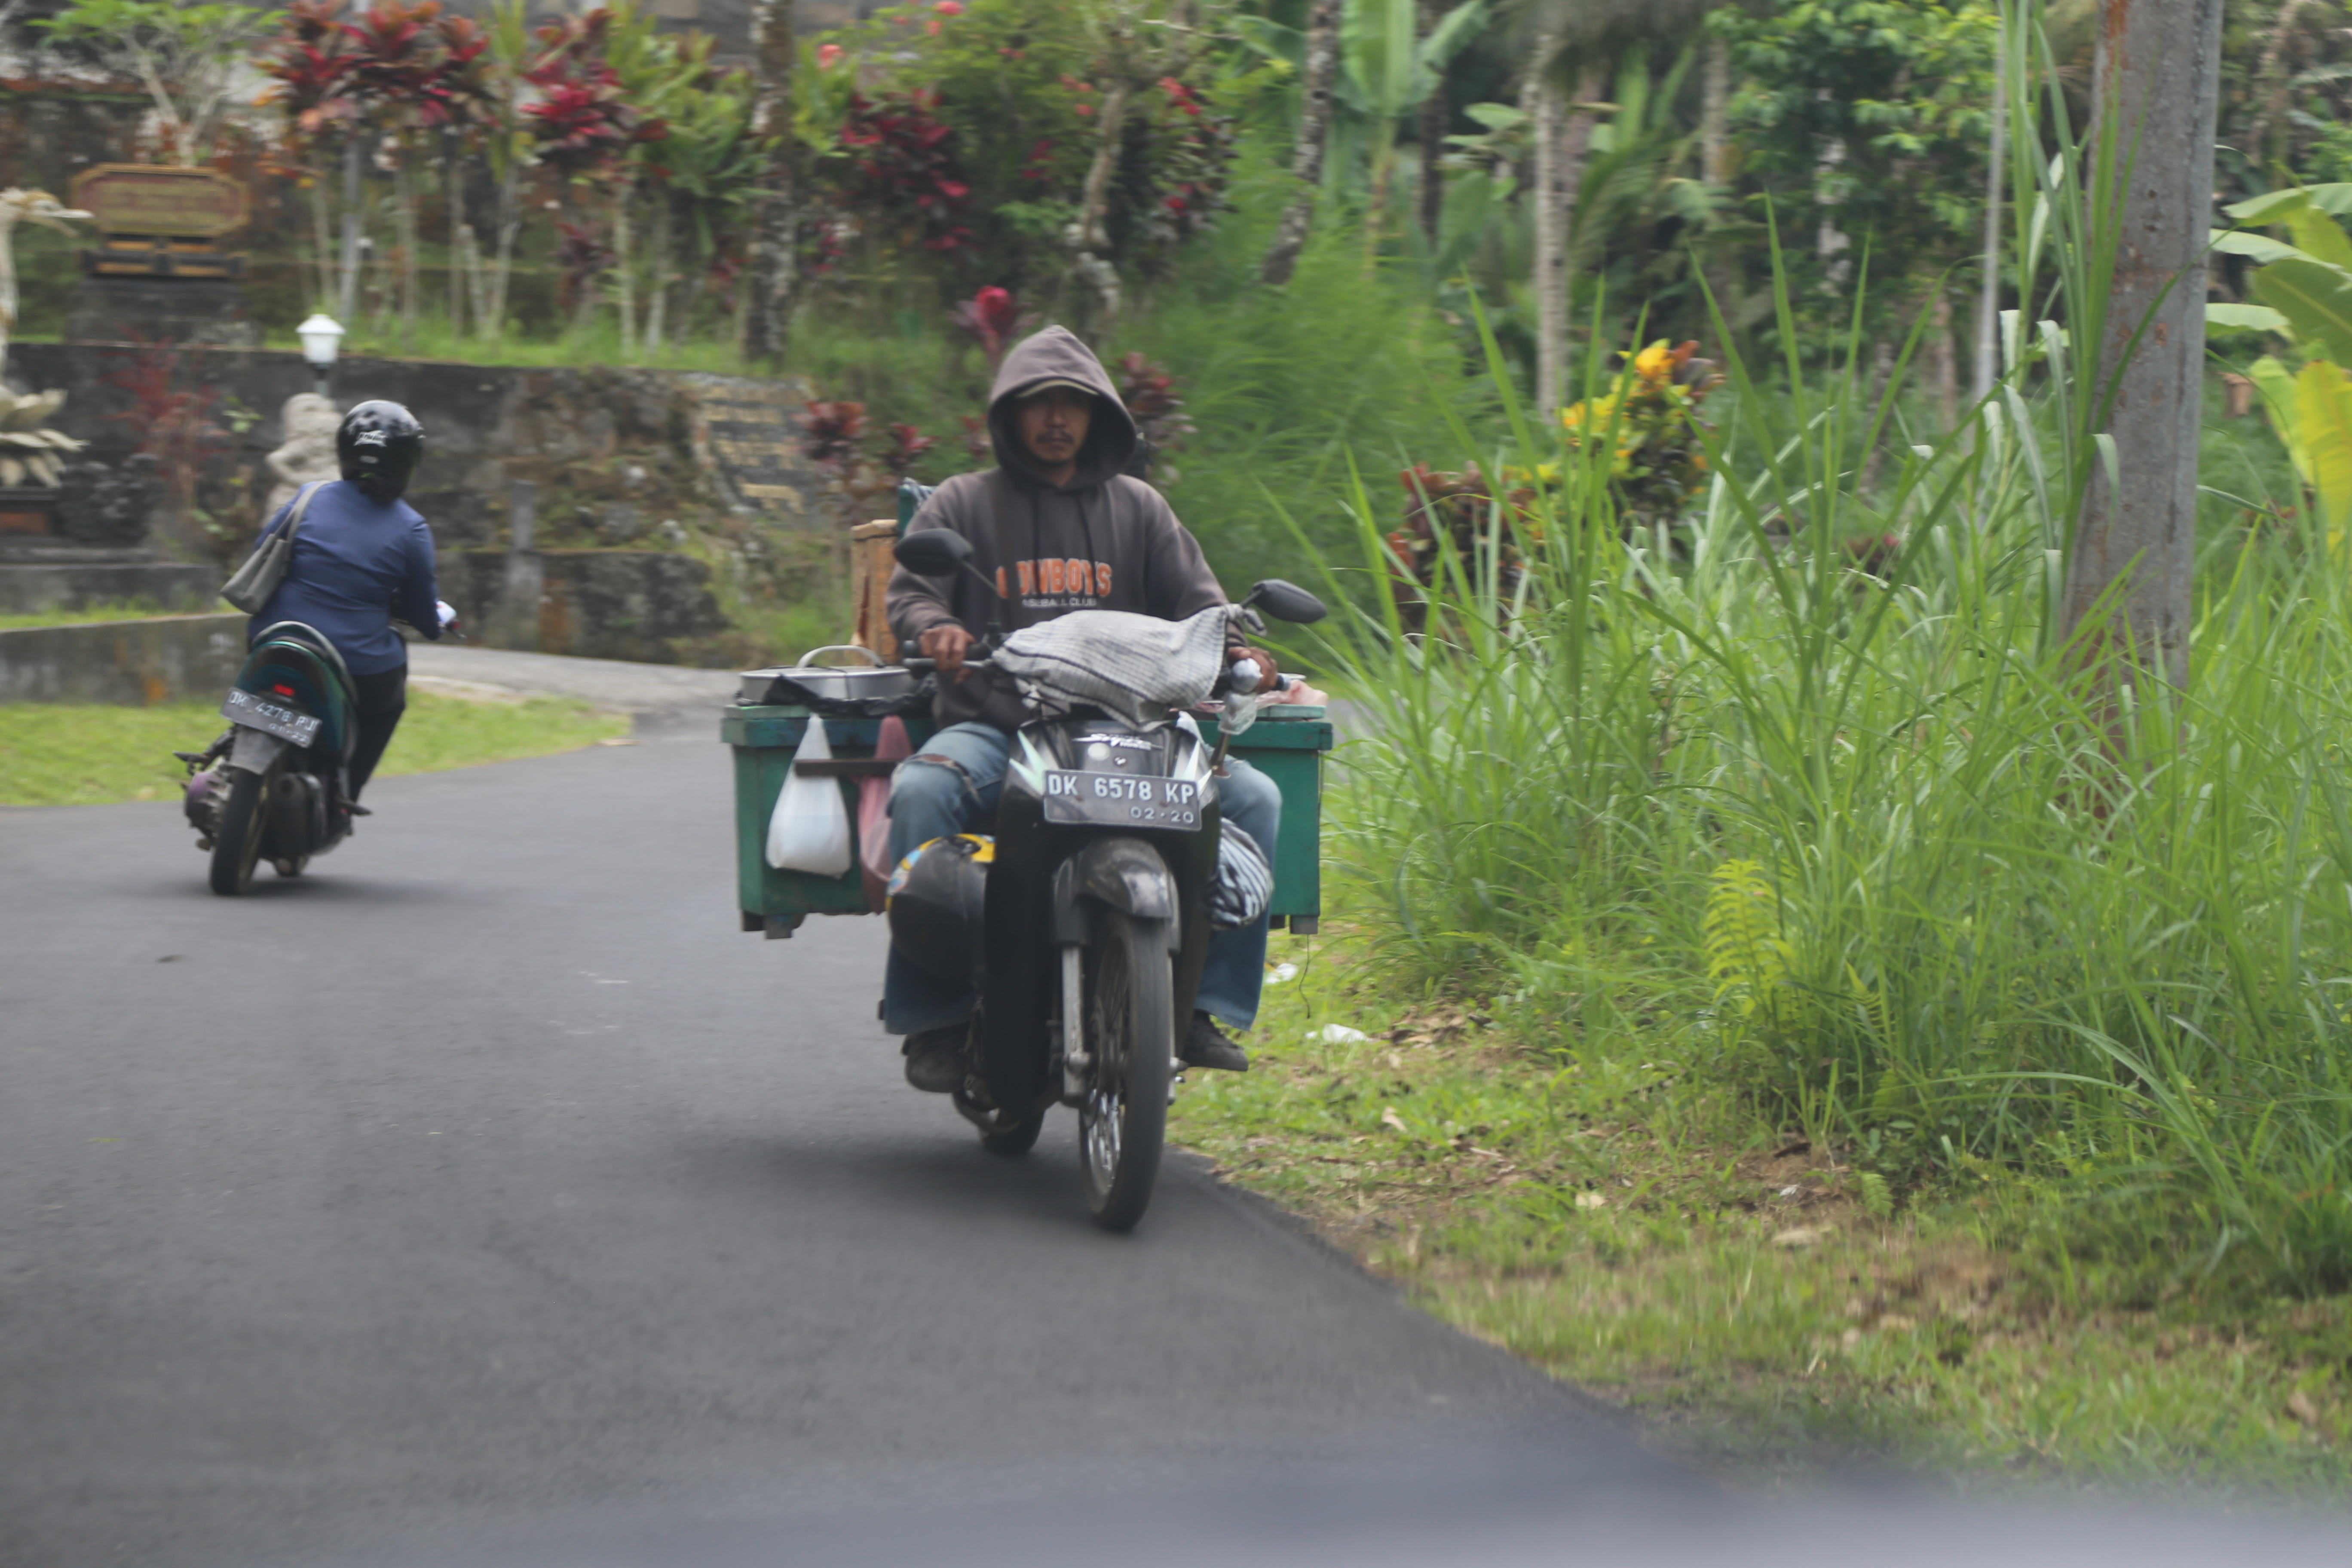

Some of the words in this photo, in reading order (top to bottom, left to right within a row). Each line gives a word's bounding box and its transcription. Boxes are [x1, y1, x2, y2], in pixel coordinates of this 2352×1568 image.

[1048, 774, 1078, 796] DK
[1094, 777, 1152, 801] 6578
[1165, 782, 1194, 804] KP
